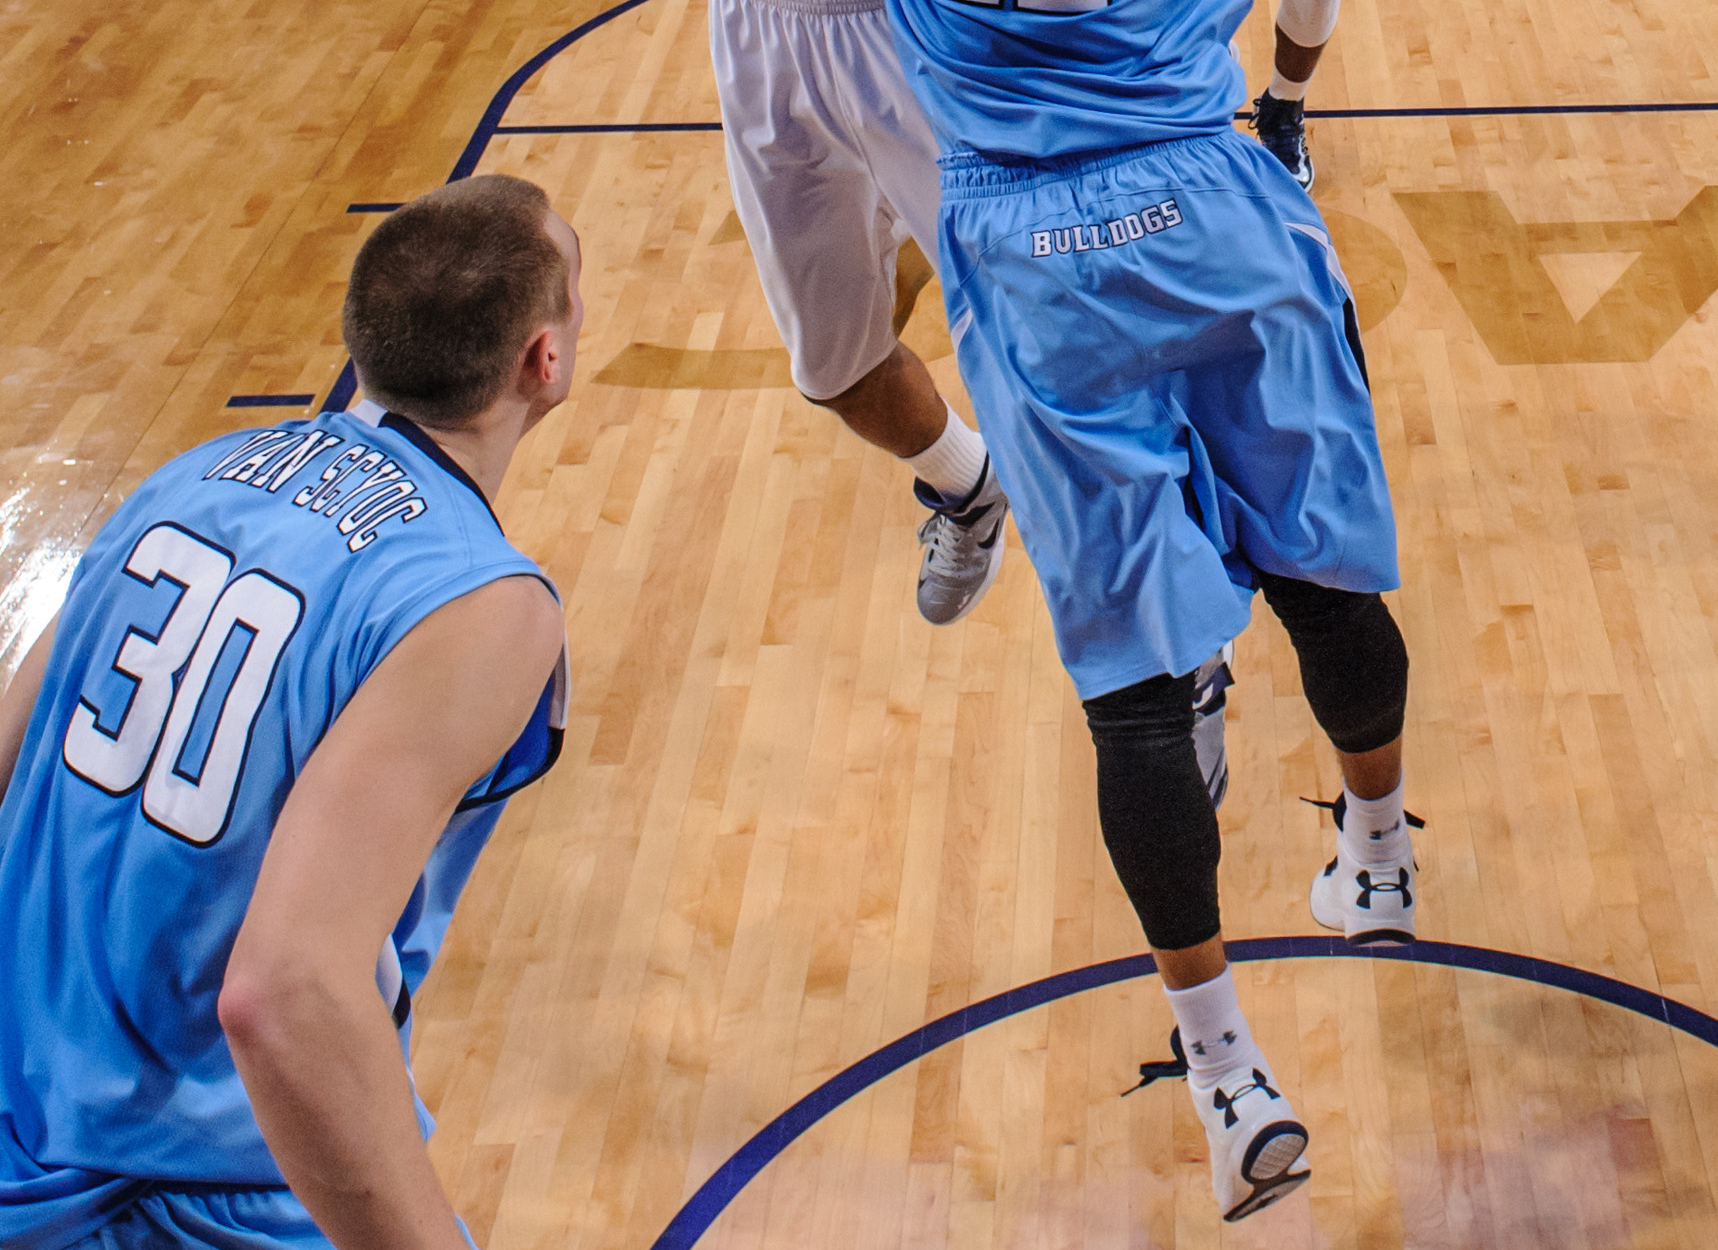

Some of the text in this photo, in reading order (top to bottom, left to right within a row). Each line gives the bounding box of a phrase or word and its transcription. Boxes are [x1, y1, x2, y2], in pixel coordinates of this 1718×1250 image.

[1031, 198, 1183, 258] BULLDOGS
[202, 429, 429, 553] VAN SCYOC
[63, 520, 307, 849] 30
